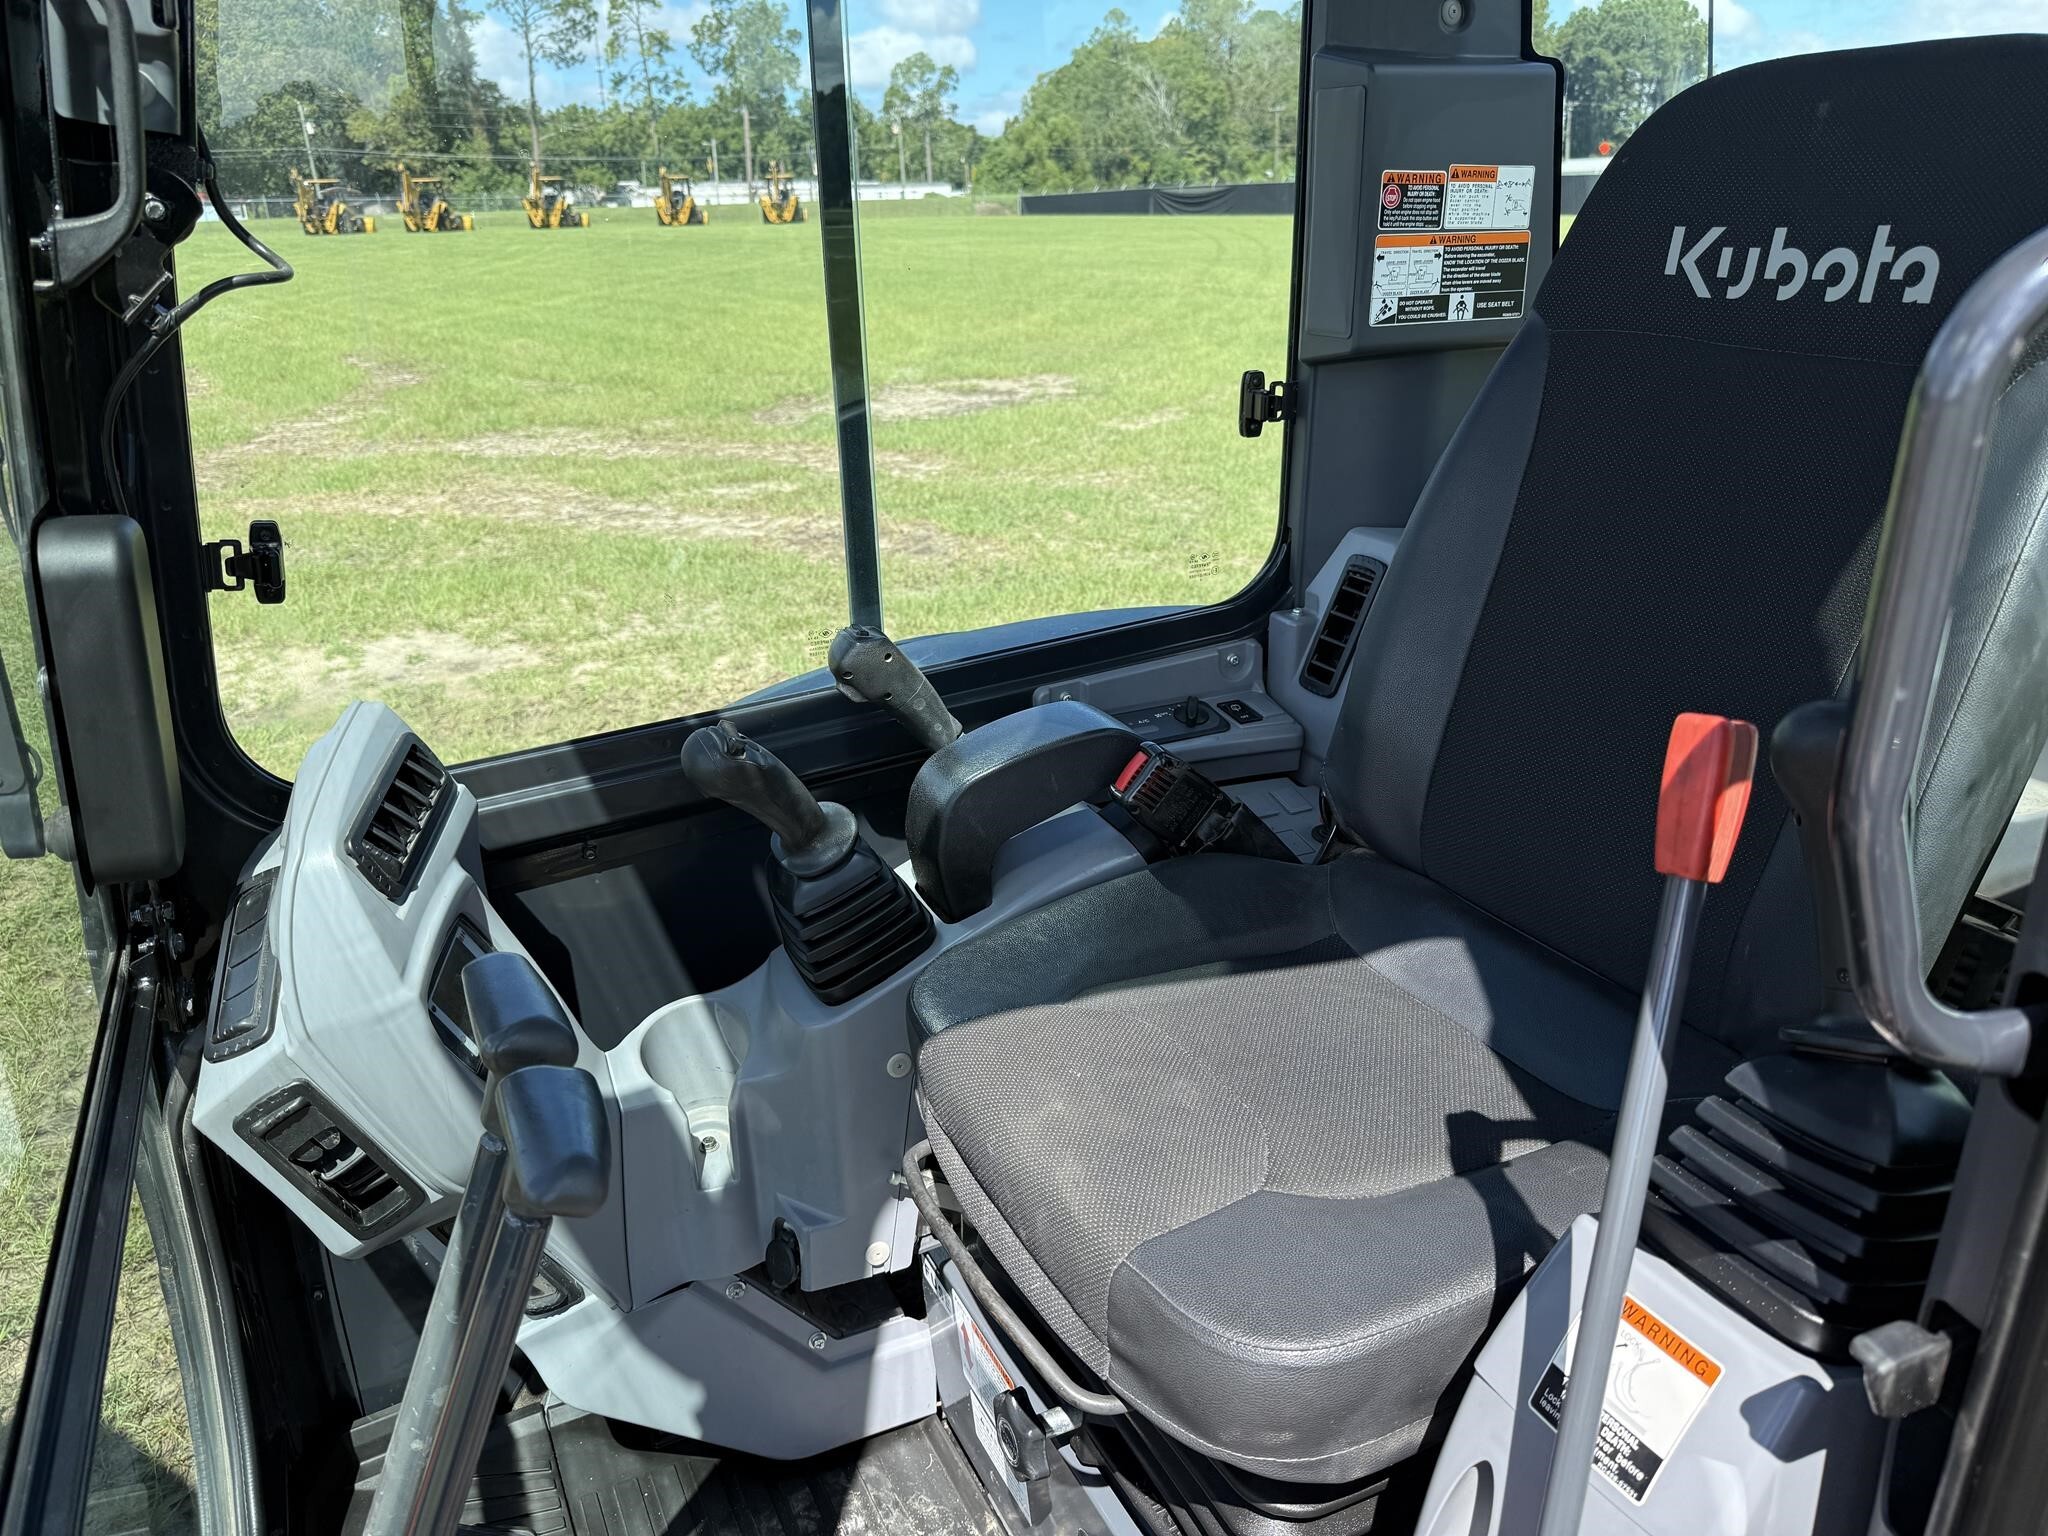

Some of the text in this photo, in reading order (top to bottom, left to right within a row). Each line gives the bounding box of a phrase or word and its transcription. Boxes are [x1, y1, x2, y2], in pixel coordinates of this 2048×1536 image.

[1397, 173, 1441, 183] WARNING
[1461, 170, 1495, 178] WARNING
[1439, 235, 1476, 243] WARNING
[1664, 225, 1940, 304] Kubota
[1620, 1330, 1641, 1350] LOCK
[1622, 1300, 1709, 1377] WARNING
[1539, 1396, 1561, 1424] leavin
[1544, 1387, 1561, 1408] Lock
[1615, 1452, 1645, 1481] before
[1600, 1410, 1640, 1451] ERSONAL
